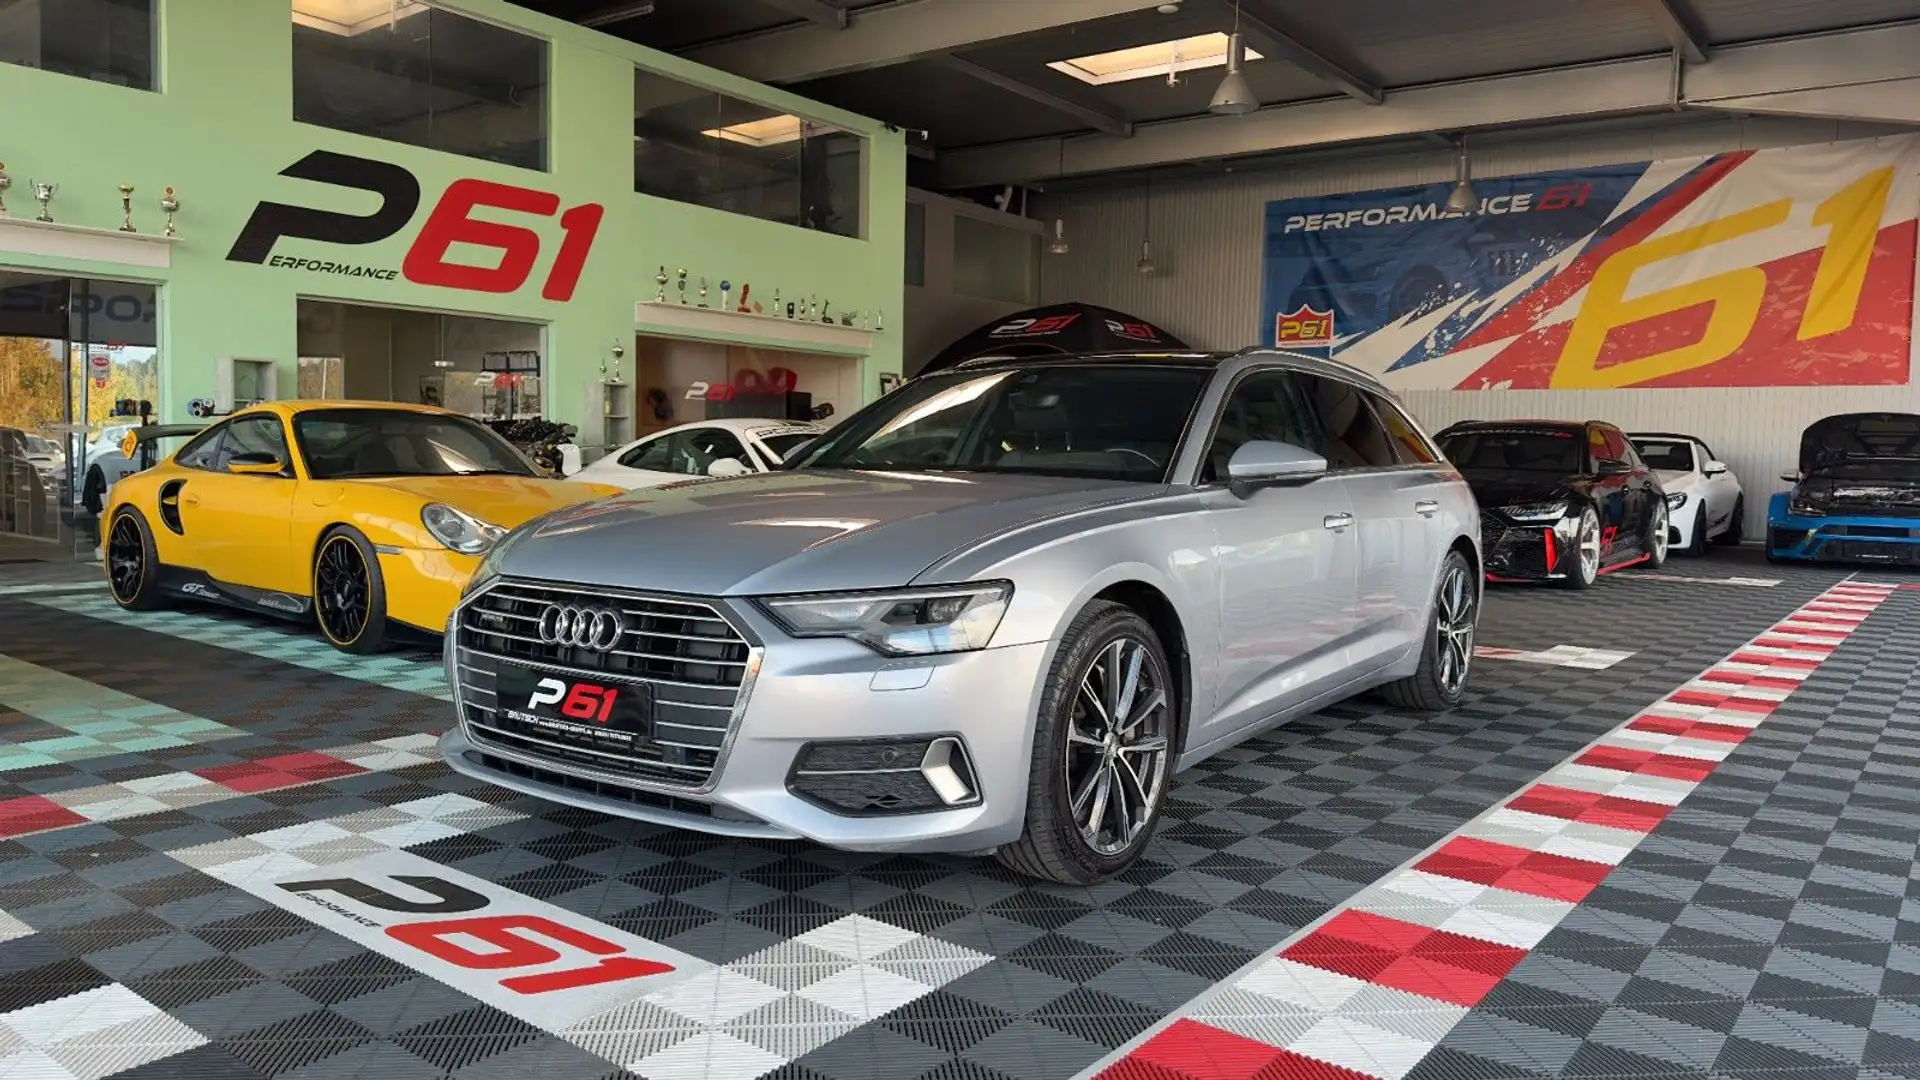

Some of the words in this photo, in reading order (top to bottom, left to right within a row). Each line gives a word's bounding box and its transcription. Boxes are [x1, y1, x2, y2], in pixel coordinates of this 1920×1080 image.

[1536, 183, 1592, 212] 61
[1549, 165, 1896, 390] 61
[1281, 319, 1328, 339] P61
[527, 677, 619, 723] P61
